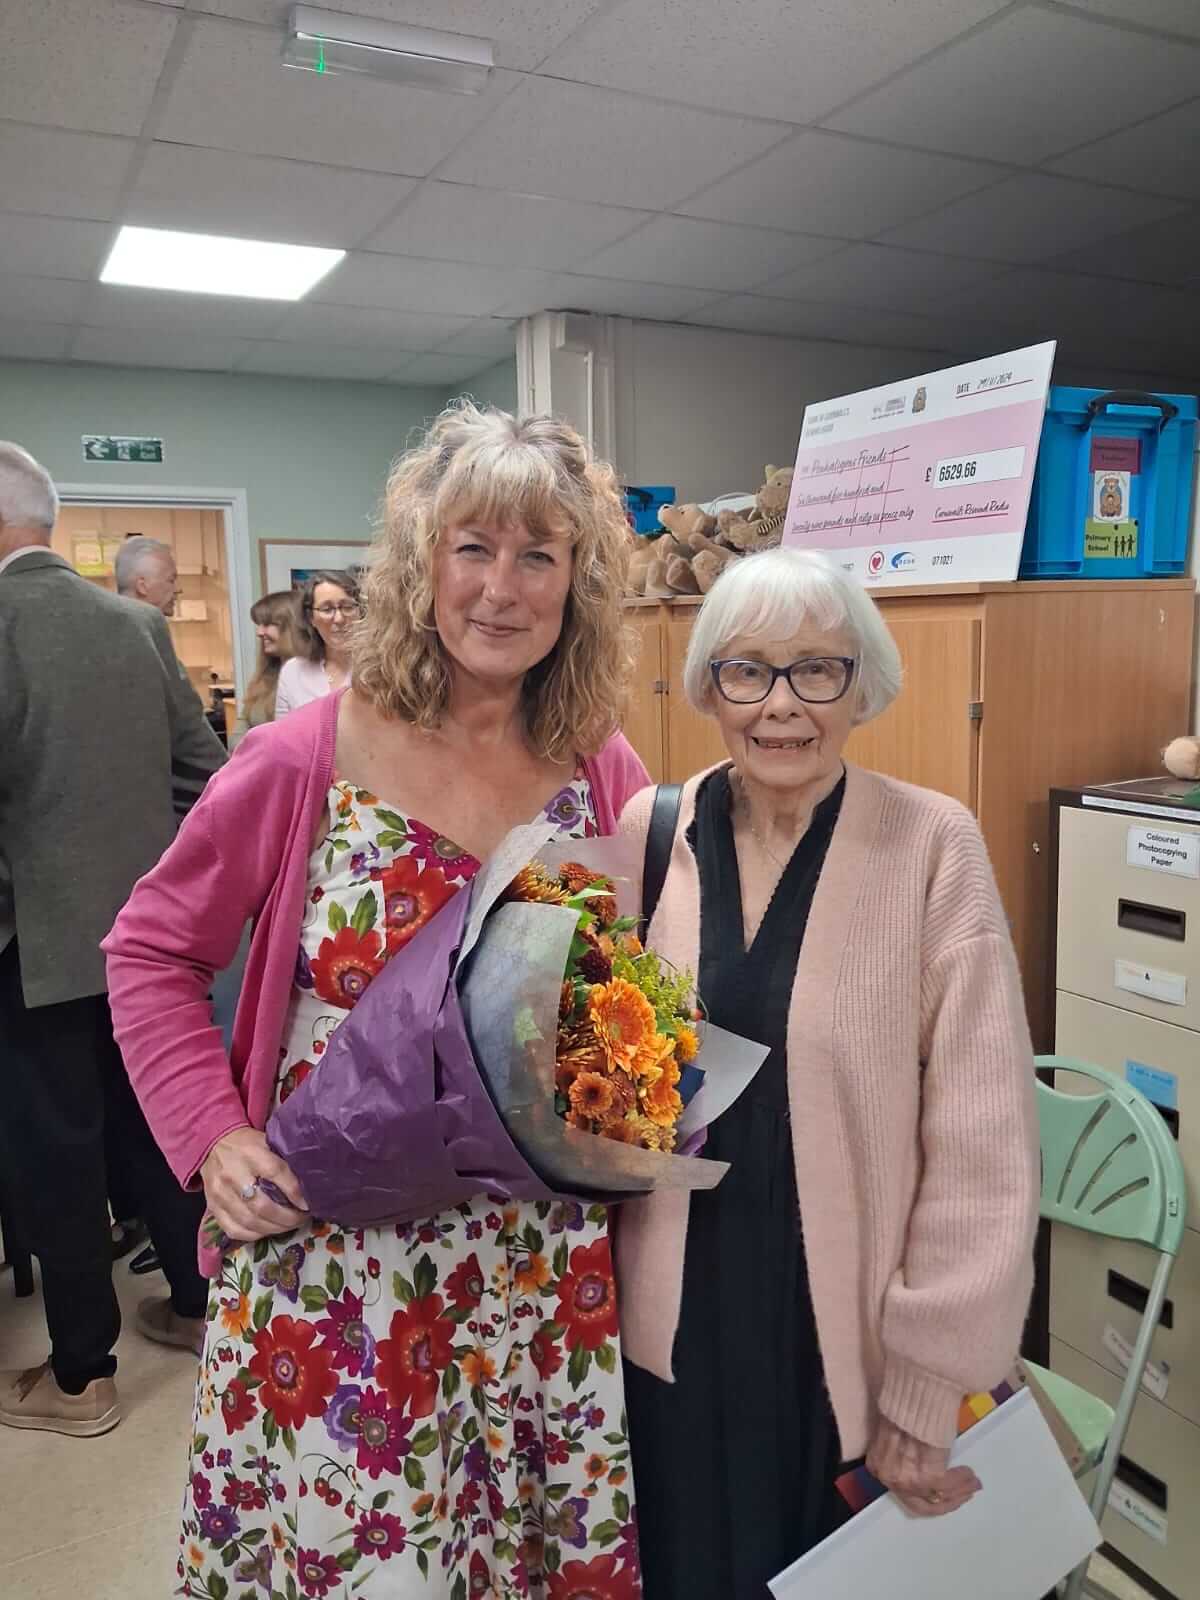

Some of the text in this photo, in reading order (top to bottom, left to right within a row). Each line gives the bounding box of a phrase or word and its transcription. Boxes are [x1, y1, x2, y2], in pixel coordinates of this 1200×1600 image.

[956, 382, 970, 395] DATE
[858, 448, 887, 465] Friends
[924, 461, 977, 482] £ 6529.66
[1085, 534, 1111, 543] Primary
[1088, 543, 1109, 552] School
[1146, 832, 1180, 845] Coloured
[1138, 842, 1188, 860] Photocopying
[1151, 856, 1173, 867] Paper
